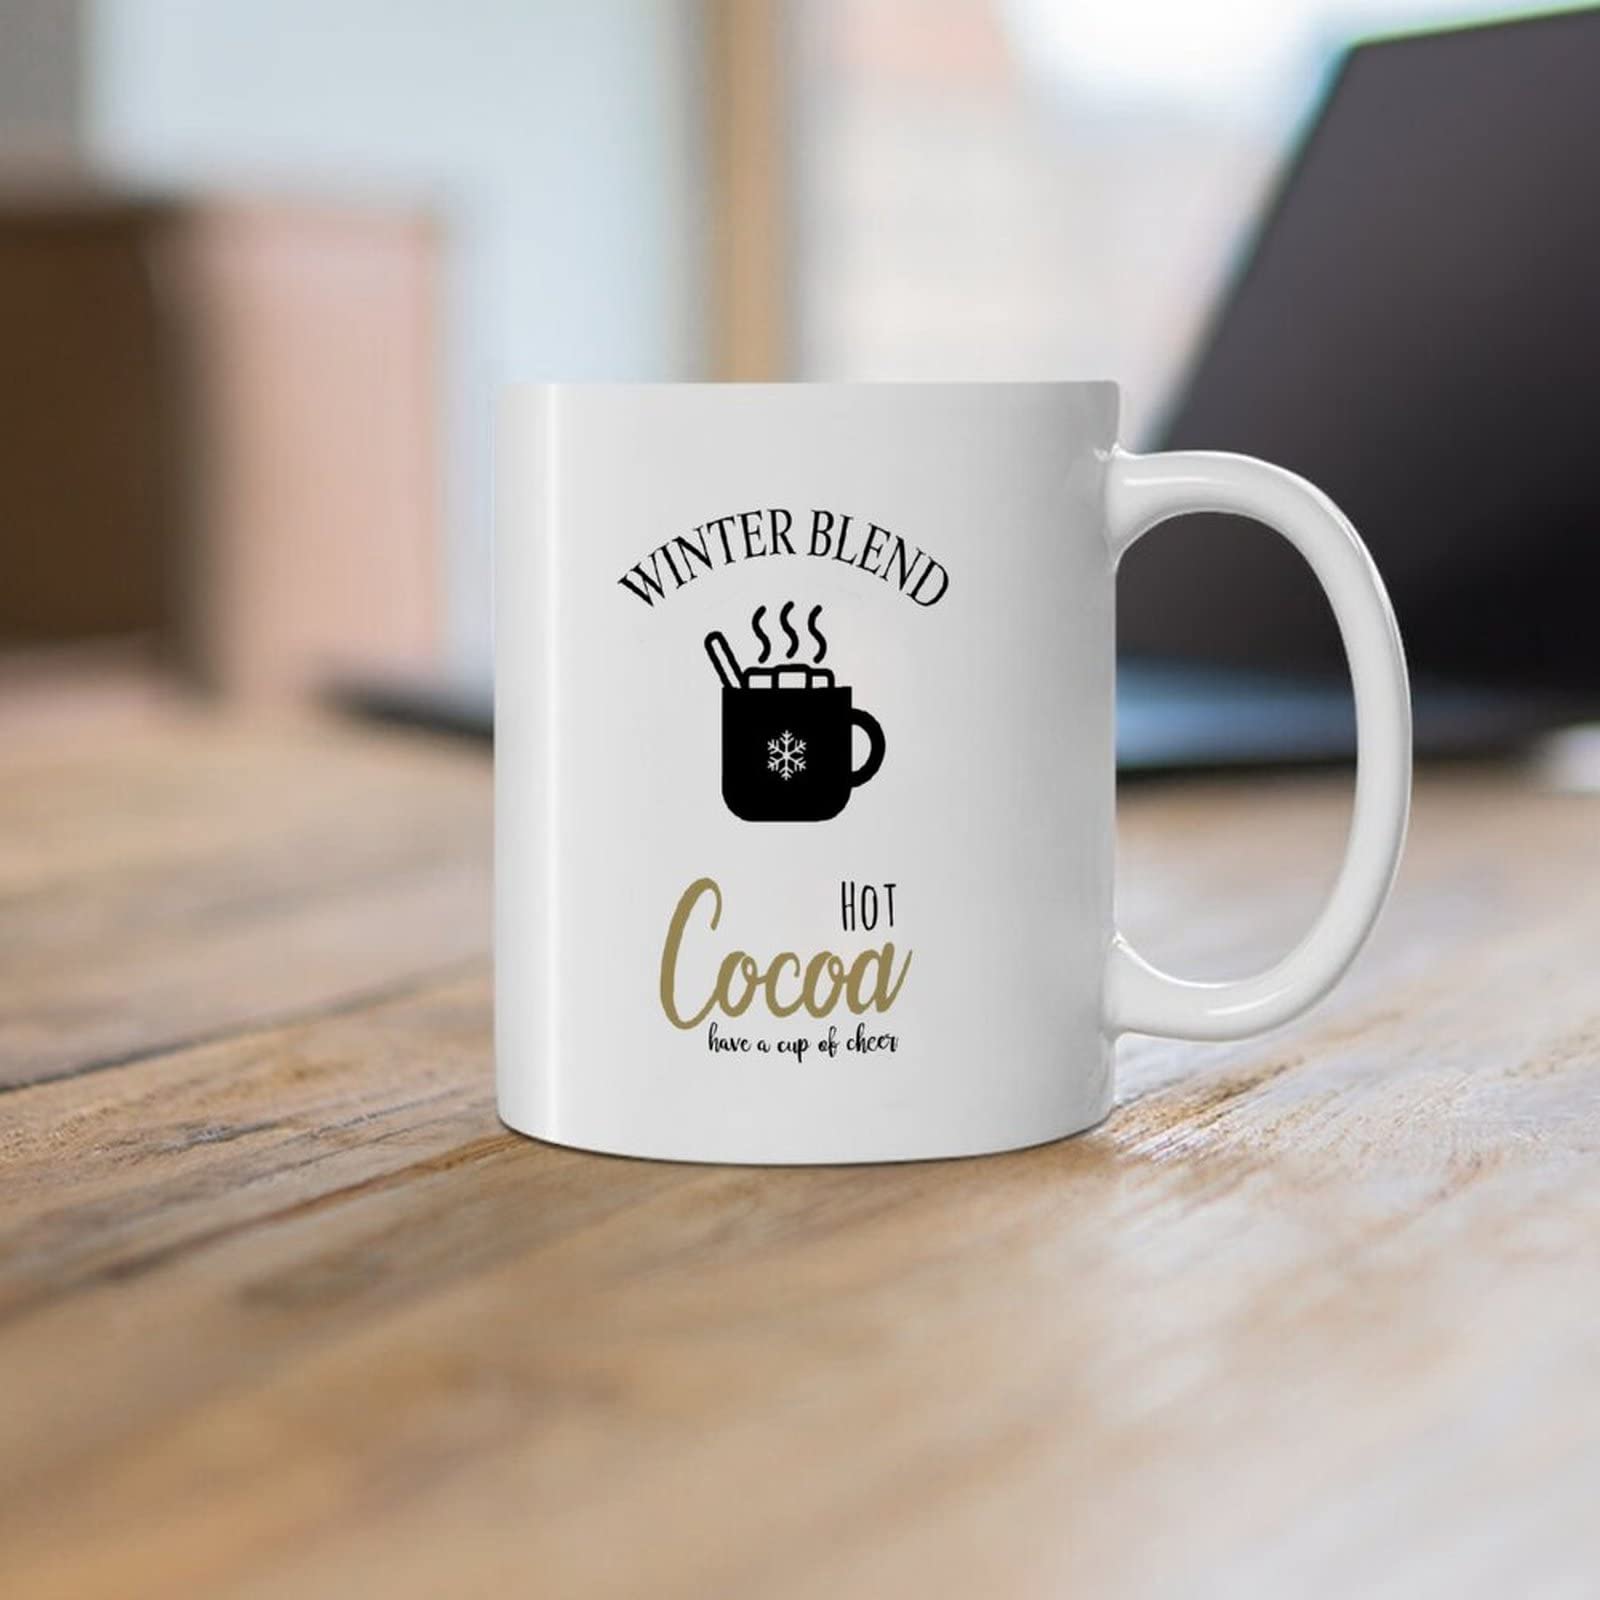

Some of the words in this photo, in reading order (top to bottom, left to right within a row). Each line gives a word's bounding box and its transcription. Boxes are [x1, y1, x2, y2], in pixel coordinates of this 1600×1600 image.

[617, 508, 797, 608] WINTER
[806, 509, 950, 608] BLEND
[841, 880, 897, 932] HOT
[659, 876, 913, 1030] Cocoa
[708, 1021, 751, 1053] have
[756, 1039, 771, 1054] a
[776, 1037, 810, 1064] cup
[817, 1025, 840, 1058] of
[846, 1022, 898, 1054] cheer
